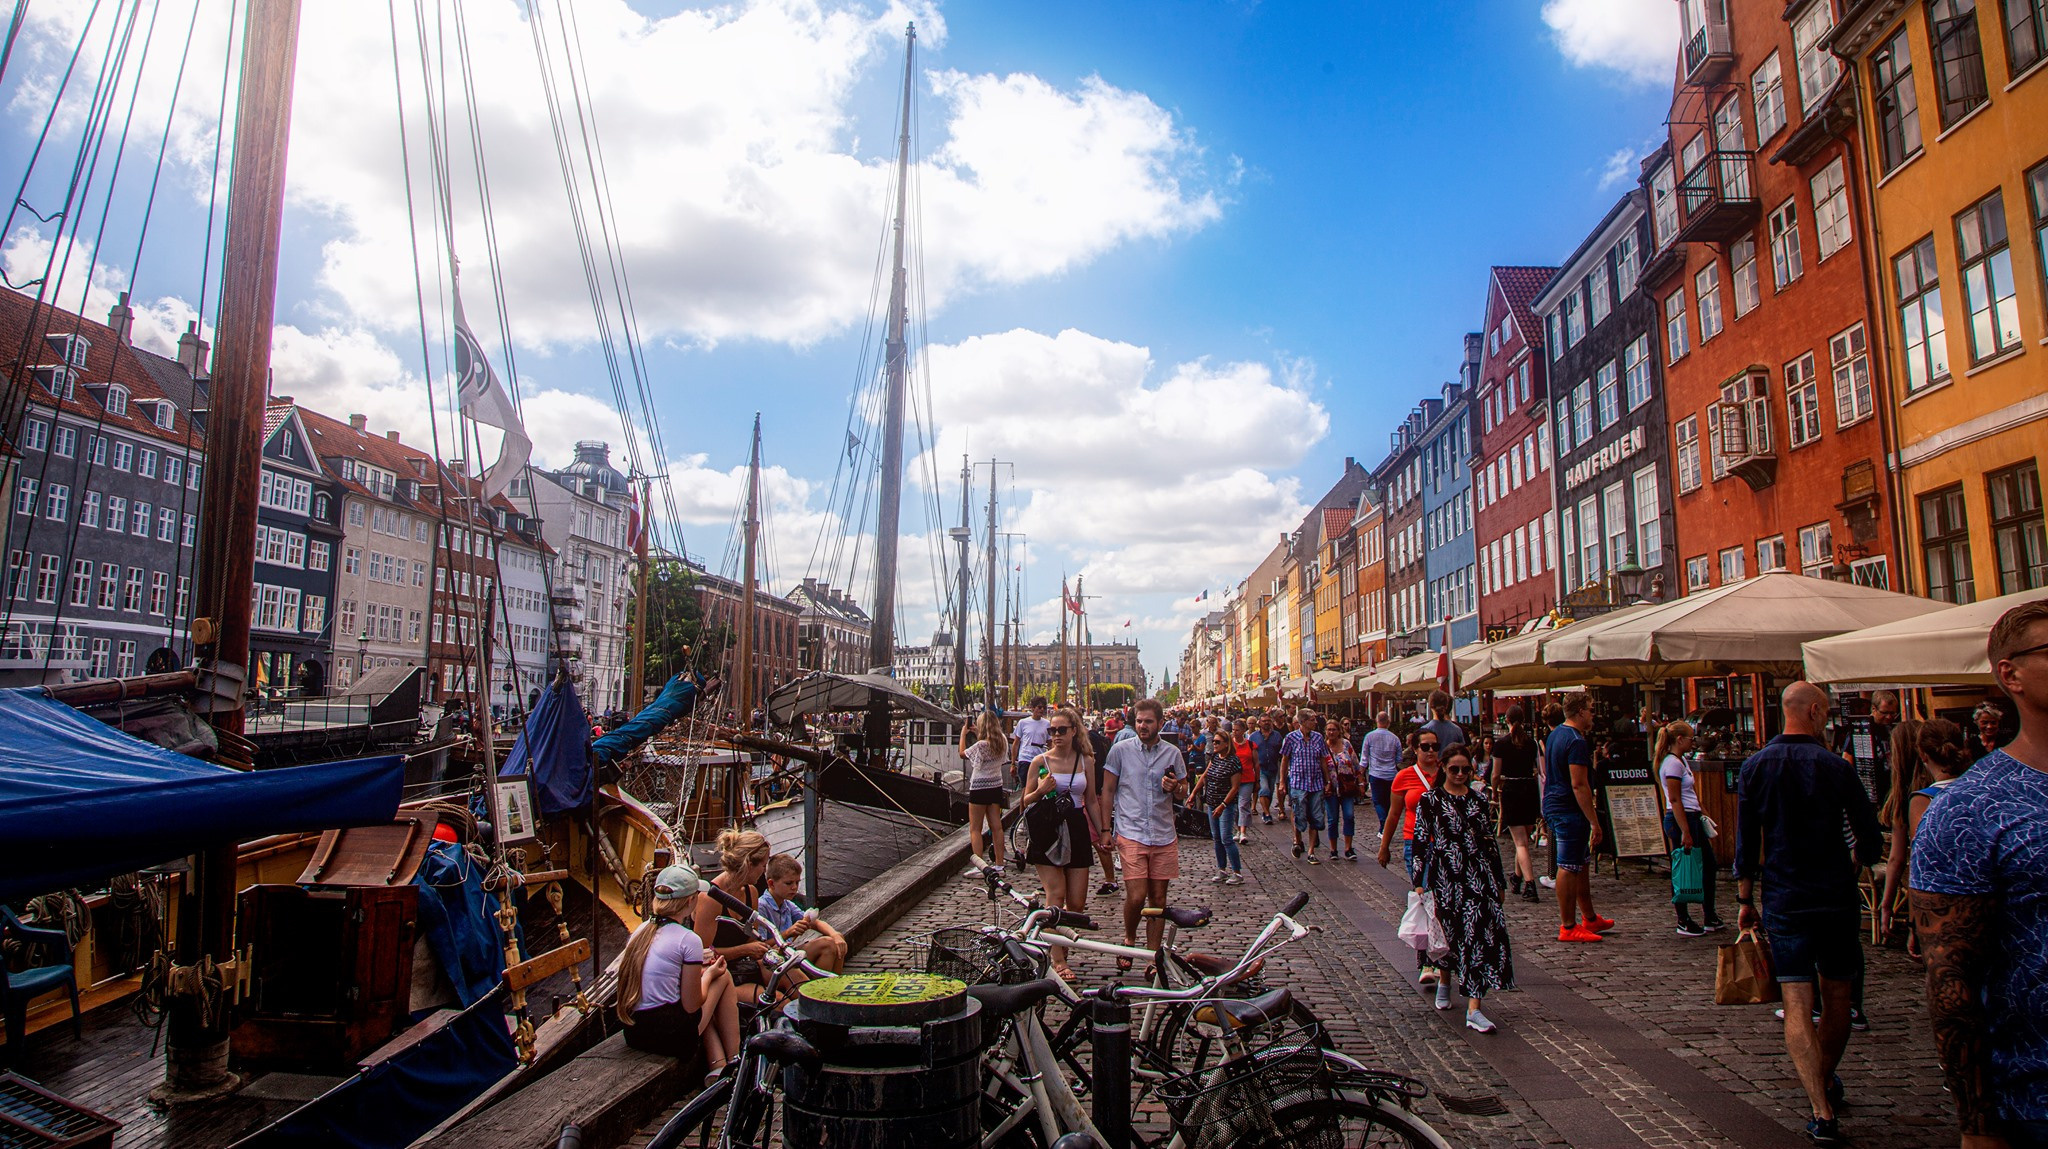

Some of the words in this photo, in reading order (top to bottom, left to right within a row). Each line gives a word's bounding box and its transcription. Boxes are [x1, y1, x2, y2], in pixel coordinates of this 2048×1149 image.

[1565, 426, 1646, 491] HAVFRUEN
[1488, 629, 1506, 643] 37
[1608, 768, 1648, 779] TUBORG
[837, 978, 886, 997] REN
[884, 978, 931, 998] KBH
